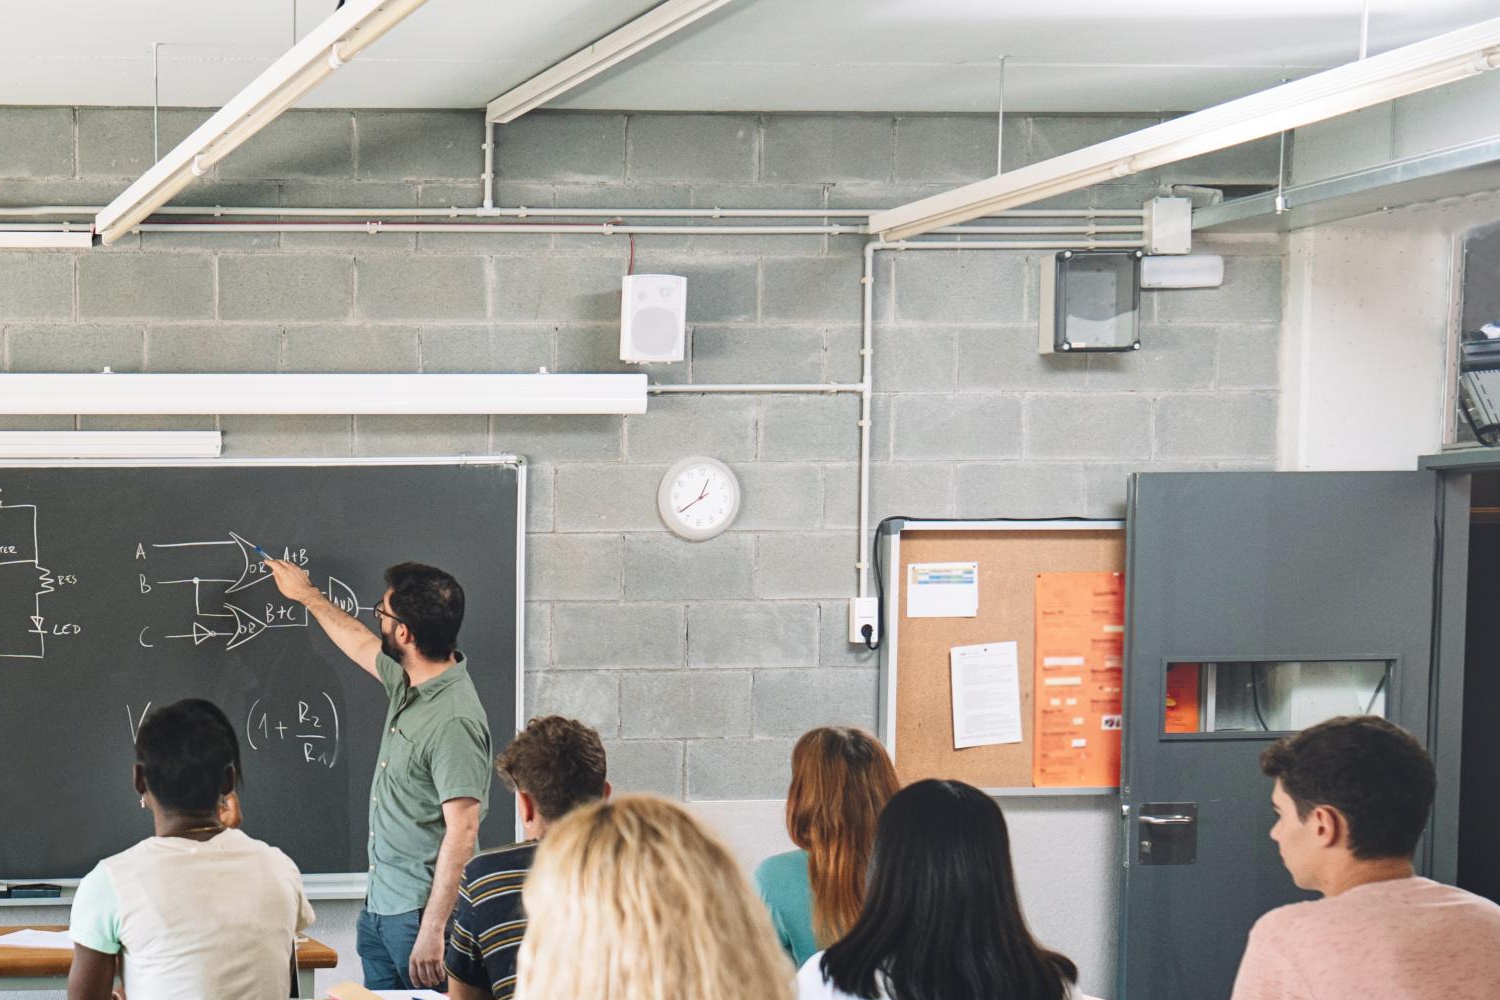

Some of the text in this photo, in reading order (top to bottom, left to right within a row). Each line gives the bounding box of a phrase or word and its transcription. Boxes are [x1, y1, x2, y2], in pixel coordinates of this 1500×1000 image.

[135, 542, 146, 559] A
[283, 546, 308, 566] A+B
[249, 561, 267, 574] OR
[57, 574, 77, 585] RES
[139, 573, 152, 594] B
[334, 595, 354, 613] AND
[265, 605, 296, 623] B+C
[53, 623, 81, 635] LED
[139, 626, 154, 648] C
[239, 623, 256, 634] OR
